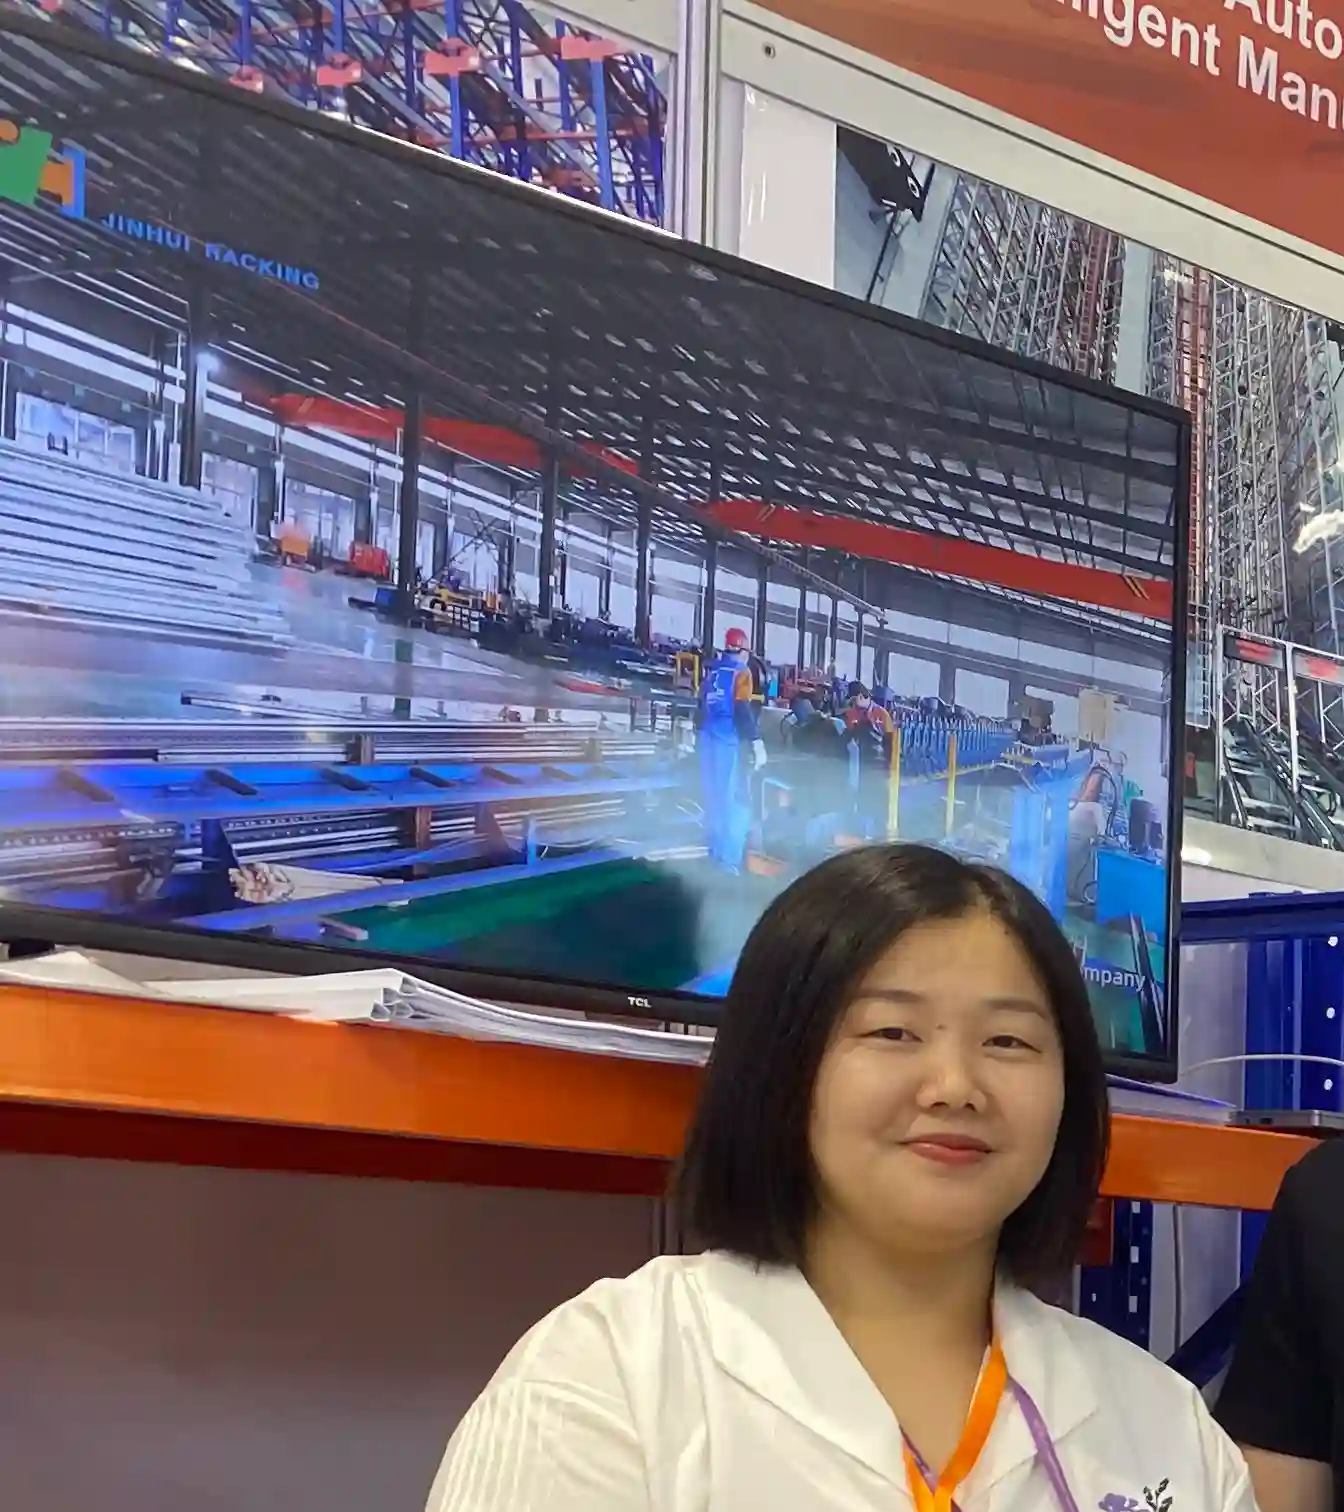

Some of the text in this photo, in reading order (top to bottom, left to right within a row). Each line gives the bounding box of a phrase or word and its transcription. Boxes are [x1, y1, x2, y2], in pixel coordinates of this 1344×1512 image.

[101, 212, 320, 290] JINHUI RACKING
[627, 996, 653, 1009] TCL
